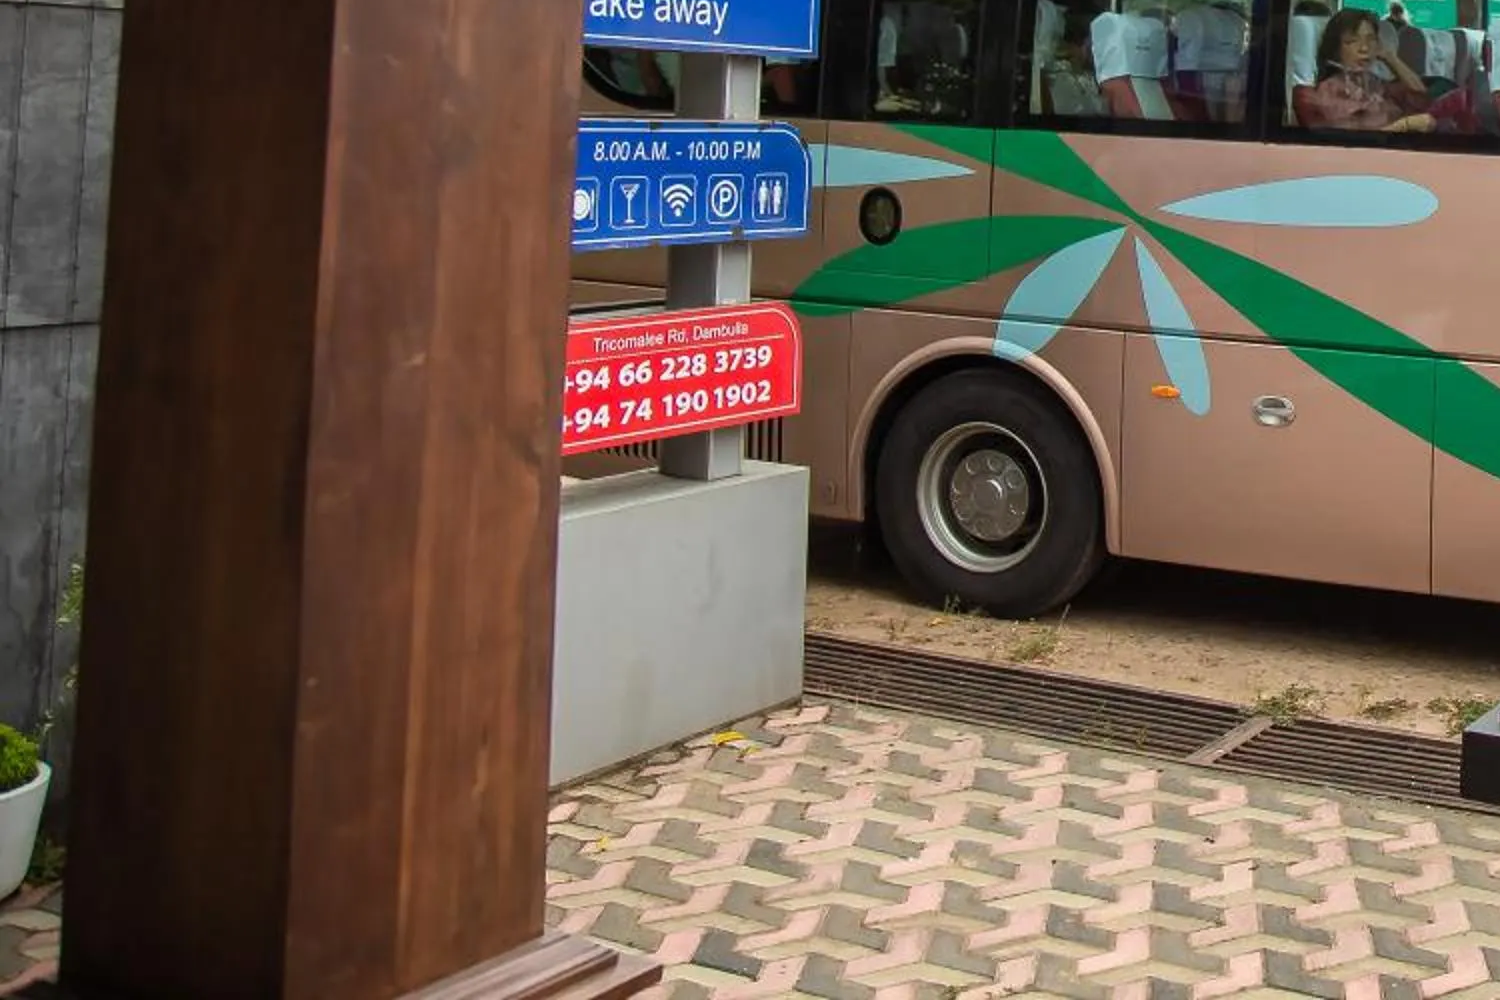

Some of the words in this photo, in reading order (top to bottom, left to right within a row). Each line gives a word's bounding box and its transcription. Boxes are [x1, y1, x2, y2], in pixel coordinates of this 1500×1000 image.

[593, 141, 630, 162] 8.00
[687, 140, 729, 161] 10.00
[618, 359, 653, 387] 66
[659, 353, 707, 382] 228
[713, 345, 773, 374] 3739
[619, 397, 653, 425] 74
[662, 389, 709, 417] 190
[713, 379, 772, 409] 1902
